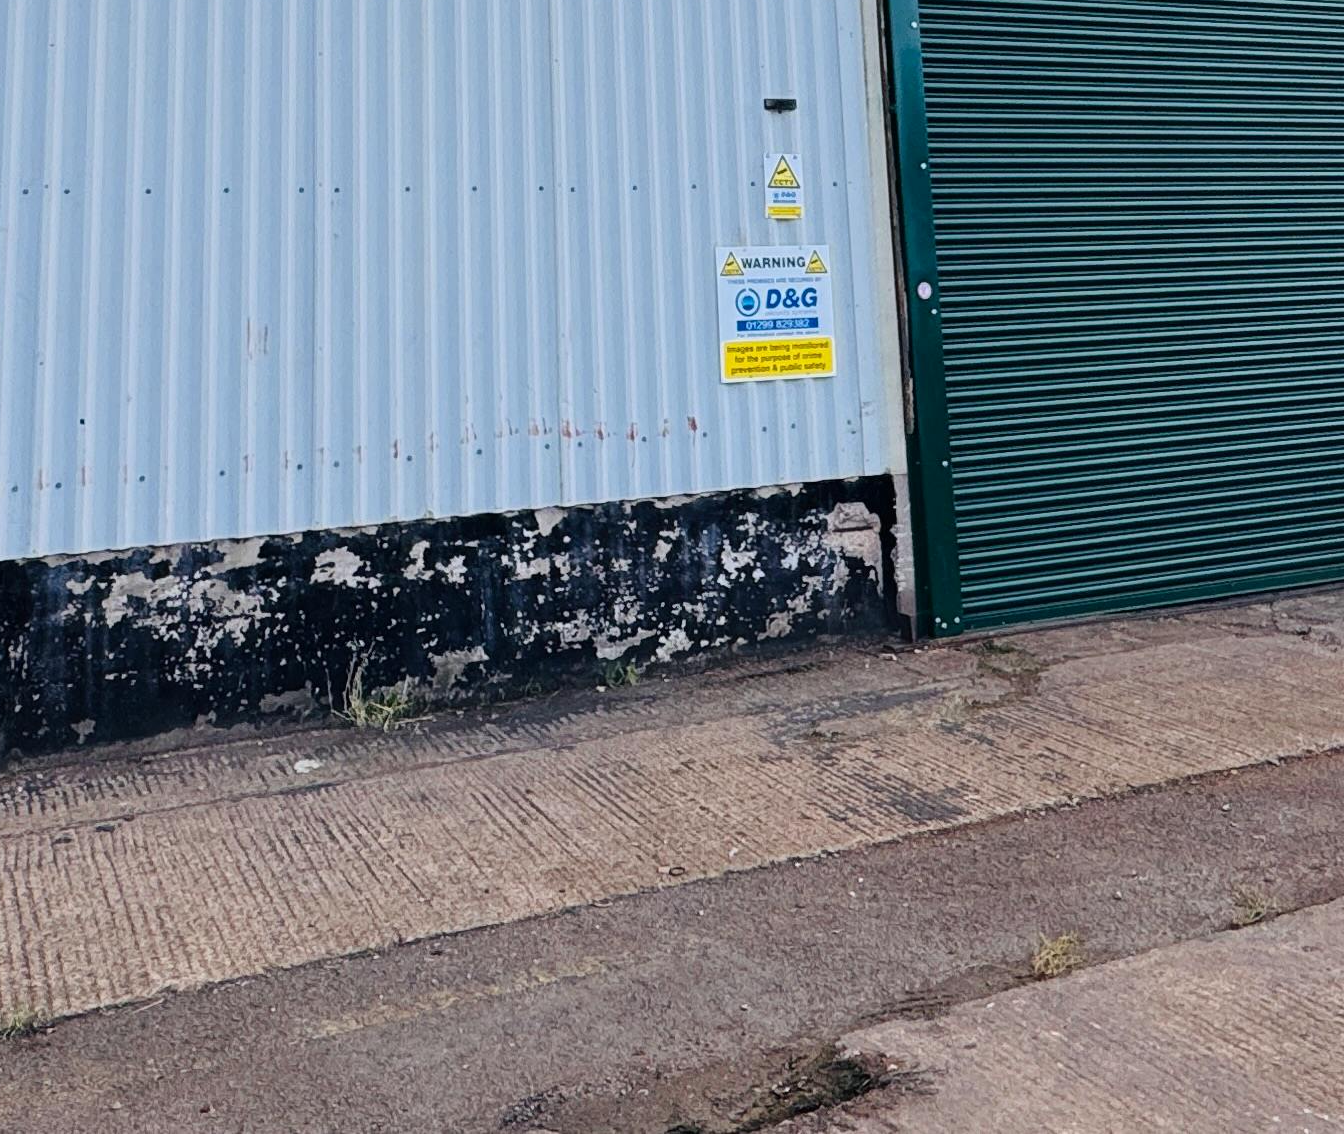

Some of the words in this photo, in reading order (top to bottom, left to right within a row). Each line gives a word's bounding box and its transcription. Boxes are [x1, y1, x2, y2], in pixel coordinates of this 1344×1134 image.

[741, 256, 806, 269] WARNING
[766, 287, 818, 309] D&G
[745, 320, 774, 330] 01299
[769, 343, 790, 353] being
[792, 341, 829, 350] monitored
[747, 355, 759, 363] the
[761, 354, 791, 364] purpose
[793, 352, 800, 360] of
[731, 365, 771, 375] prevention
[772, 364, 778, 372] &
[780, 362, 803, 372] public
[804, 362, 826, 371] safety
